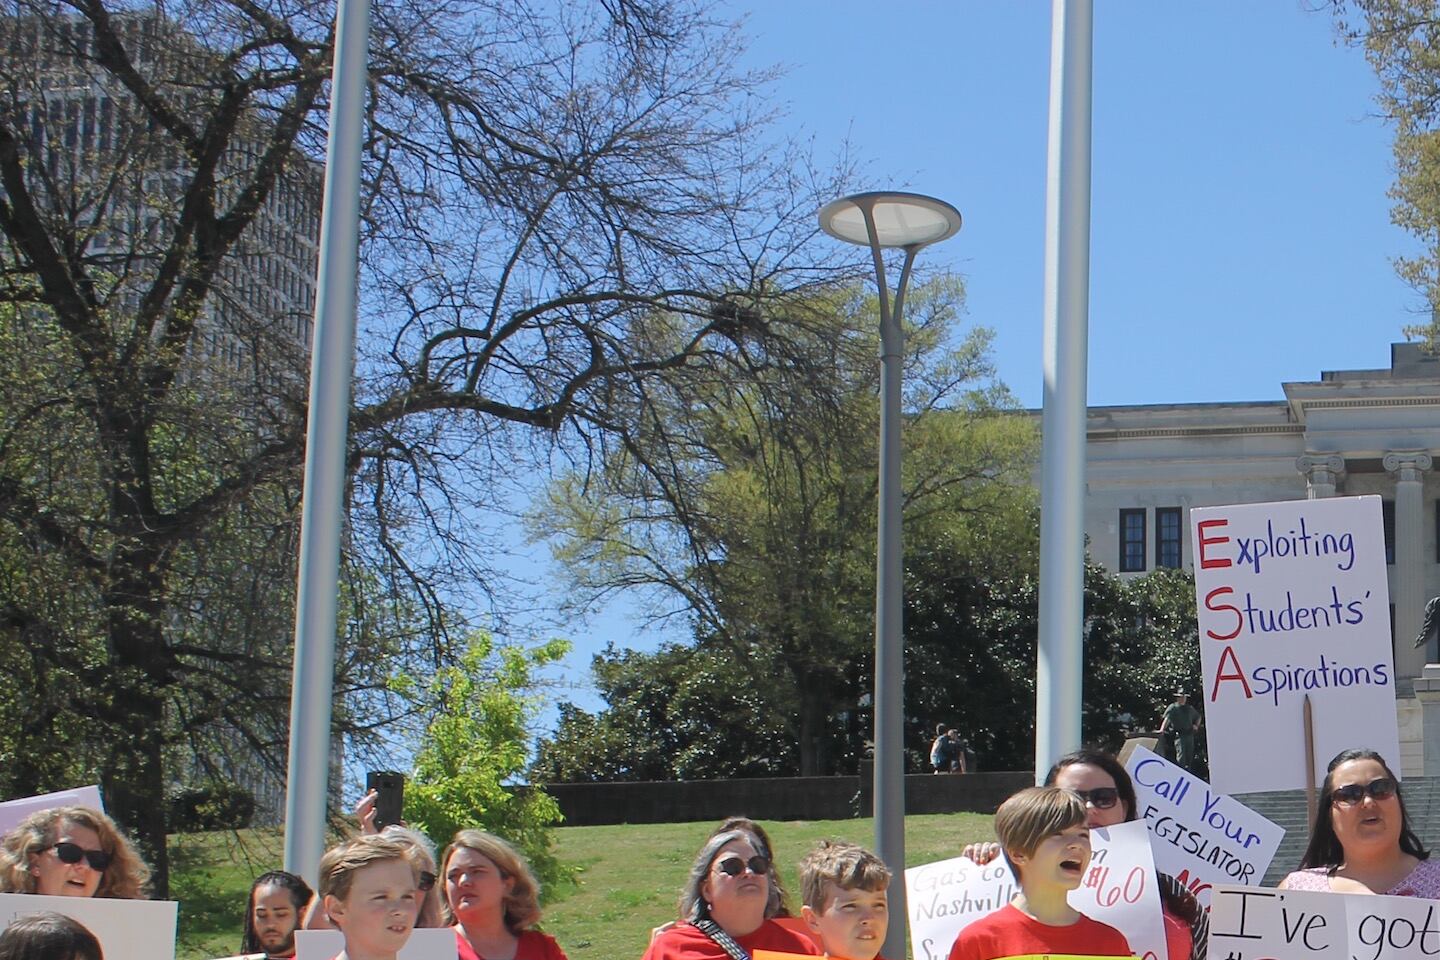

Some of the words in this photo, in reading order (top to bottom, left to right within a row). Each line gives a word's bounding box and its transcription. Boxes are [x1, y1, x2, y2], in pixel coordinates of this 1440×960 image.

[1198, 518, 1355, 574] Exploiting
[1205, 586, 1370, 641] Students'
[1211, 646, 1388, 706] Aspirations
[1134, 759, 1190, 806] Call
[1200, 790, 1261, 848] Your
[1143, 805, 1255, 886] EGISLATOR
[1084, 864, 1145, 907] $60
[1212, 891, 1330, 951] I've
